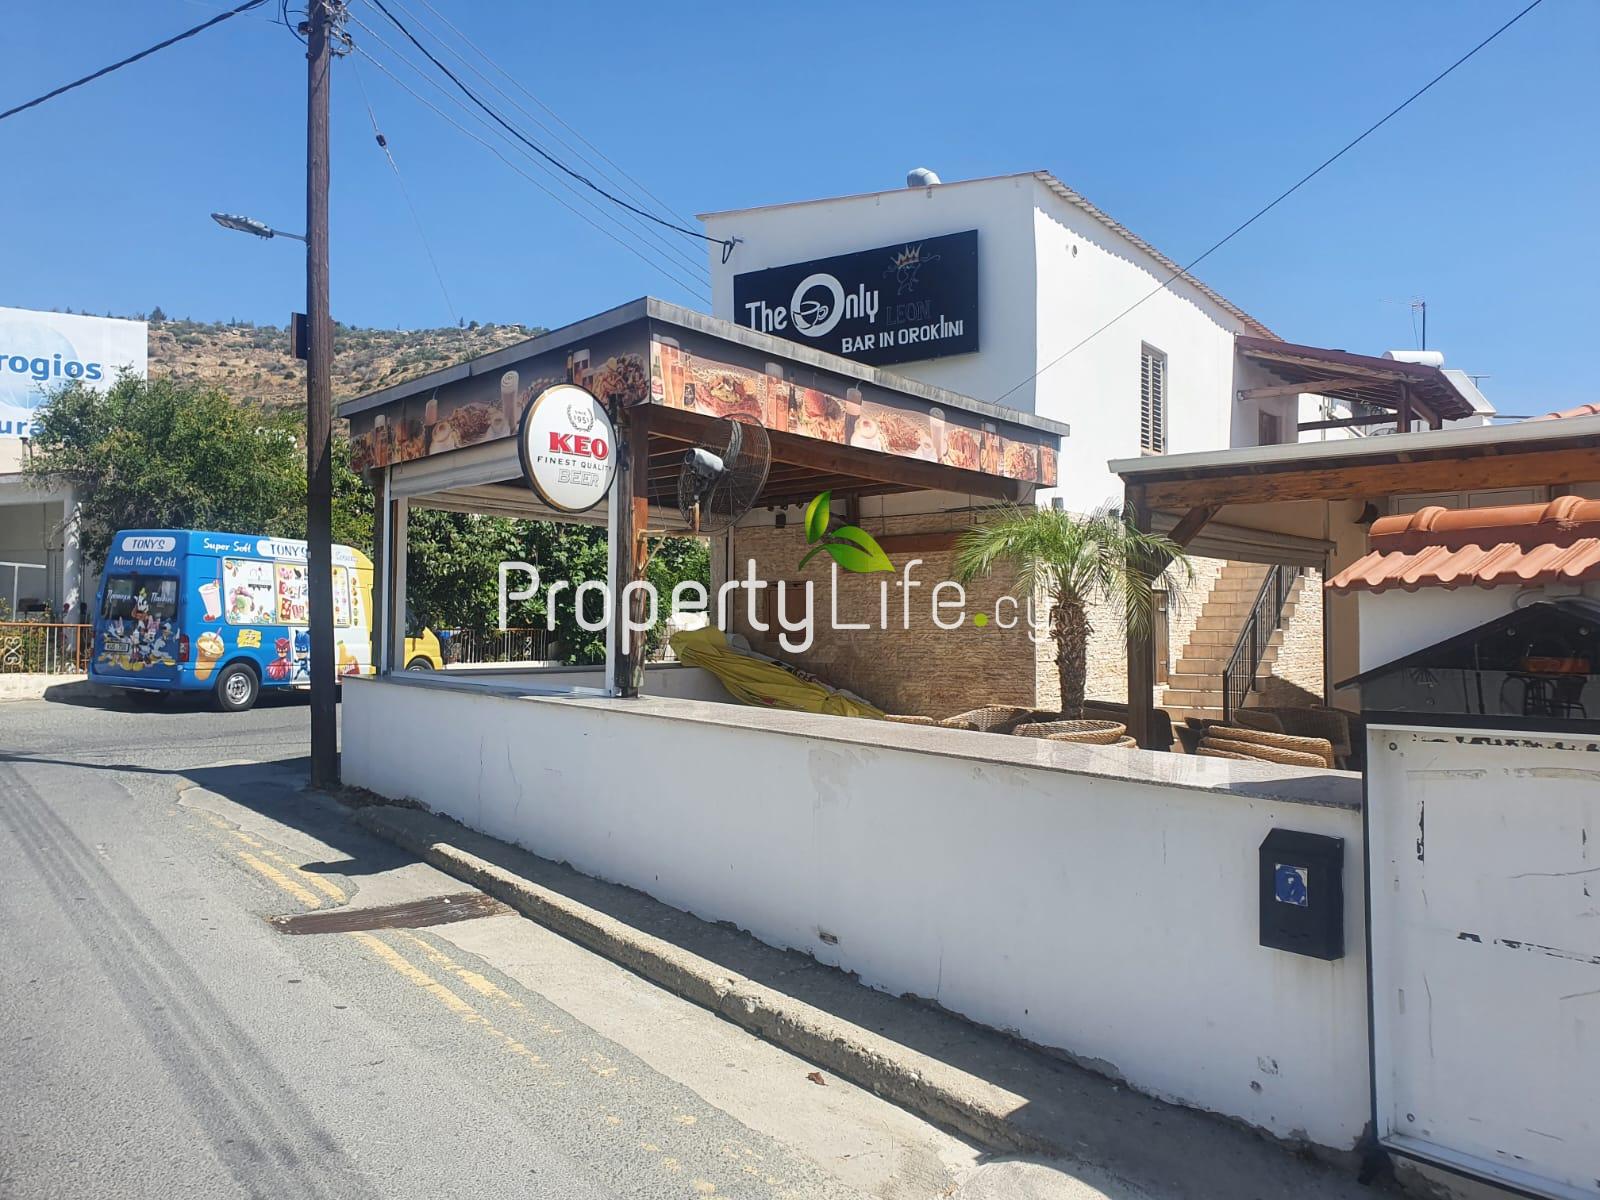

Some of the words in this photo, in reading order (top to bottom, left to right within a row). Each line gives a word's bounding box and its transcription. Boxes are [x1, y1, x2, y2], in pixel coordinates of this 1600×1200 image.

[745, 301, 788, 333] The
[790, 273, 879, 337] Only
[841, 331, 875, 353] BAR
[879, 331, 895, 347] IN
[549, 432, 608, 460] KEO
[538, 456, 576, 467] FINEST
[558, 469, 599, 487] BEER
[203, 537, 231, 553] Super
[233, 540, 252, 553] Soft
[113, 555, 134, 566] Mind
[135, 555, 152, 566] that
[153, 555, 177, 567] Child
